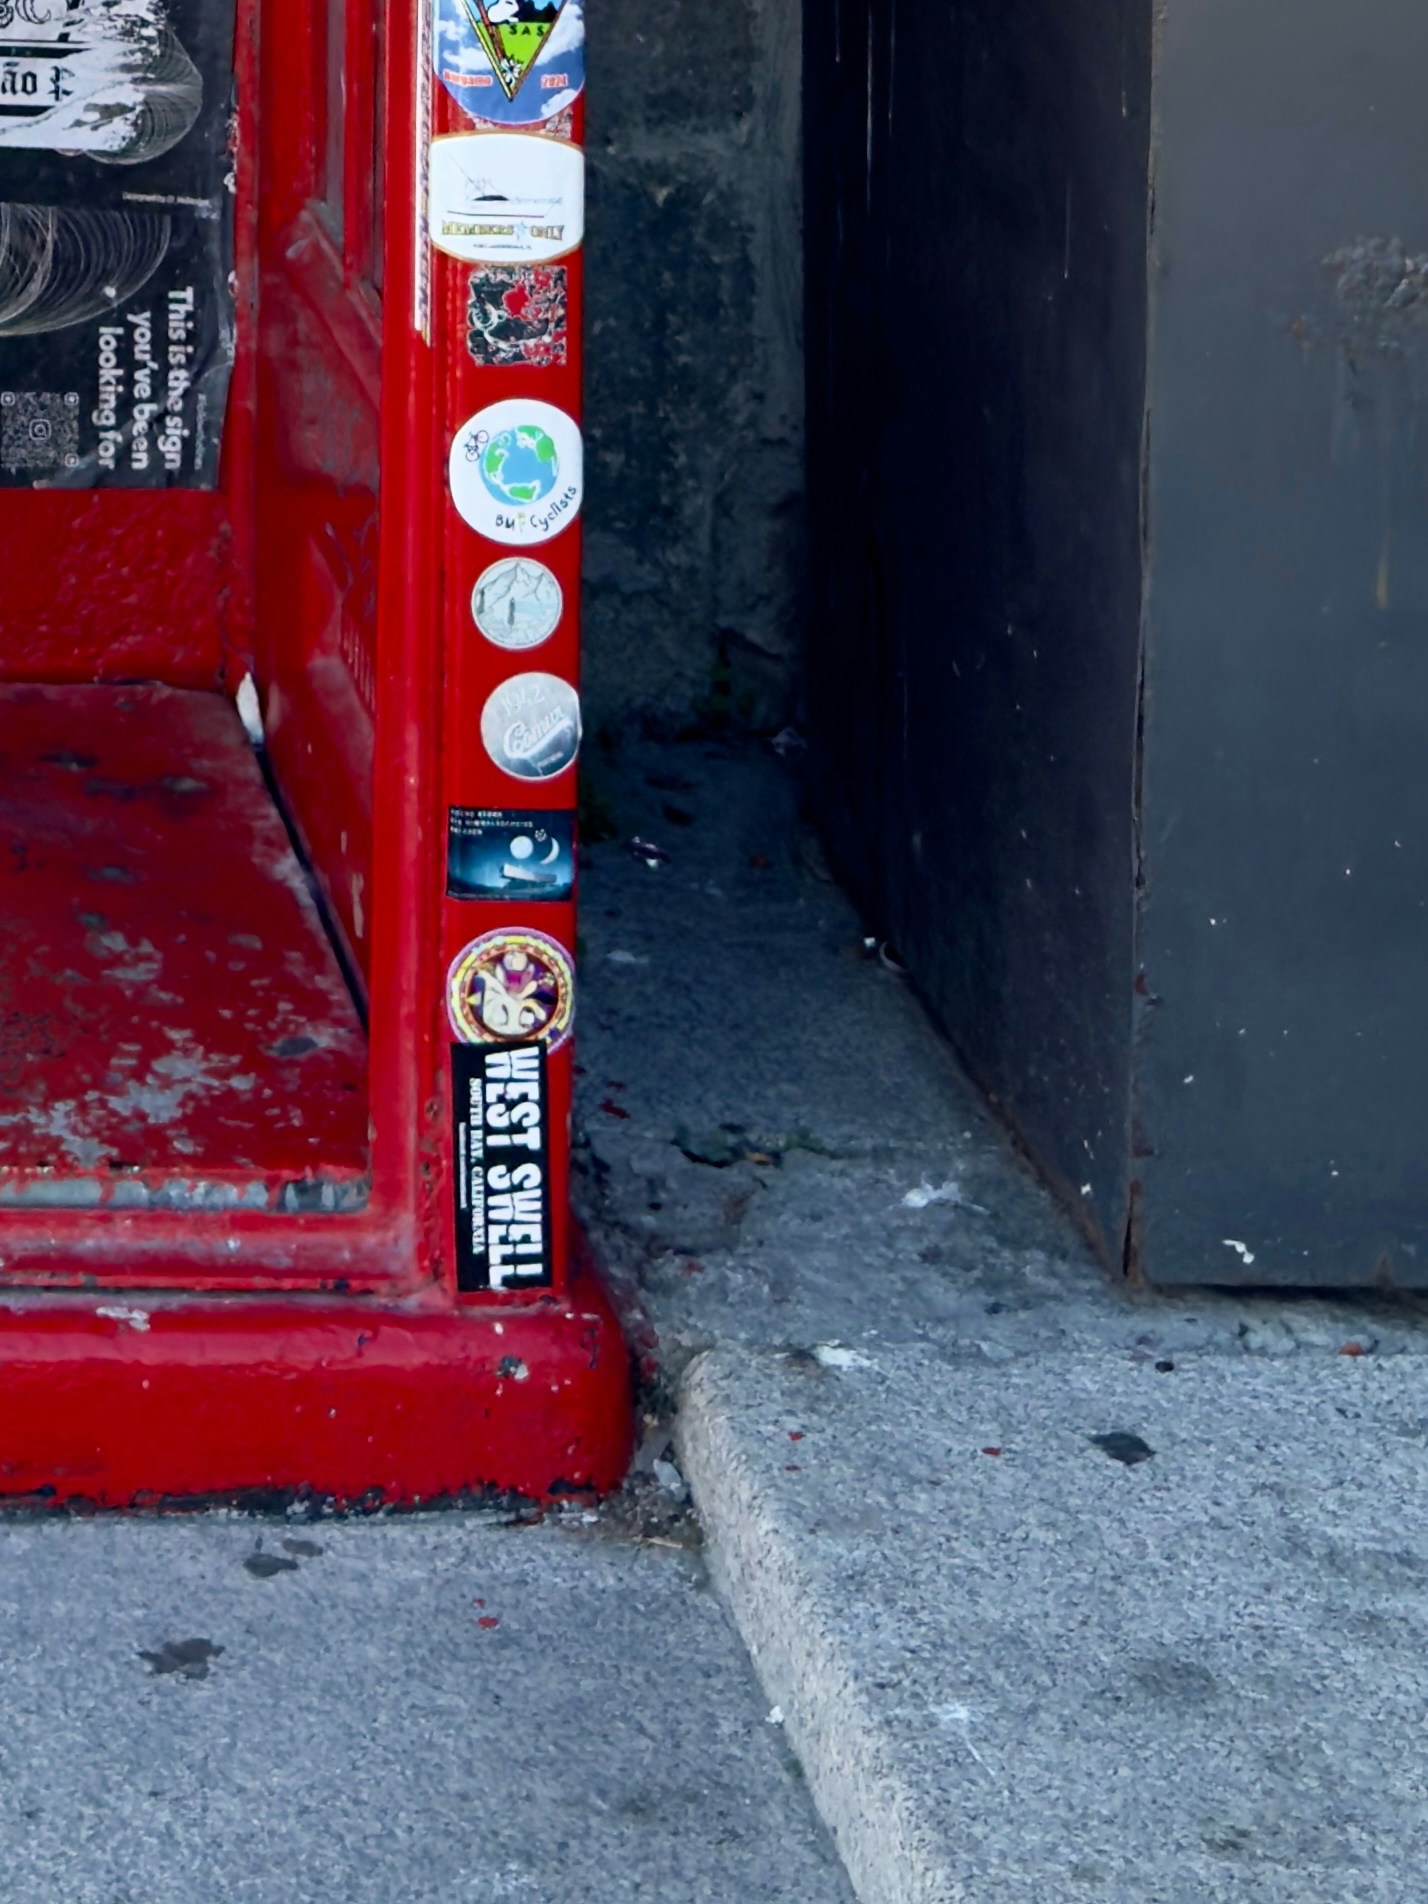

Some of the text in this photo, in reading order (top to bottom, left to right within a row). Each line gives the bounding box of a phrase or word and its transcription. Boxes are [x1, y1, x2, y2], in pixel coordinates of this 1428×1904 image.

[91, 326, 124, 471] looking for
[126, 311, 159, 471] you've been
[157, 286, 194, 471] This is the sign
[529, 485, 578, 532] Cyclists
[469, 1077, 484, 1126] SOUTH
[484, 1045, 544, 1290] WEST SWELL
[471, 1165, 486, 1256] CALIFORNIA
